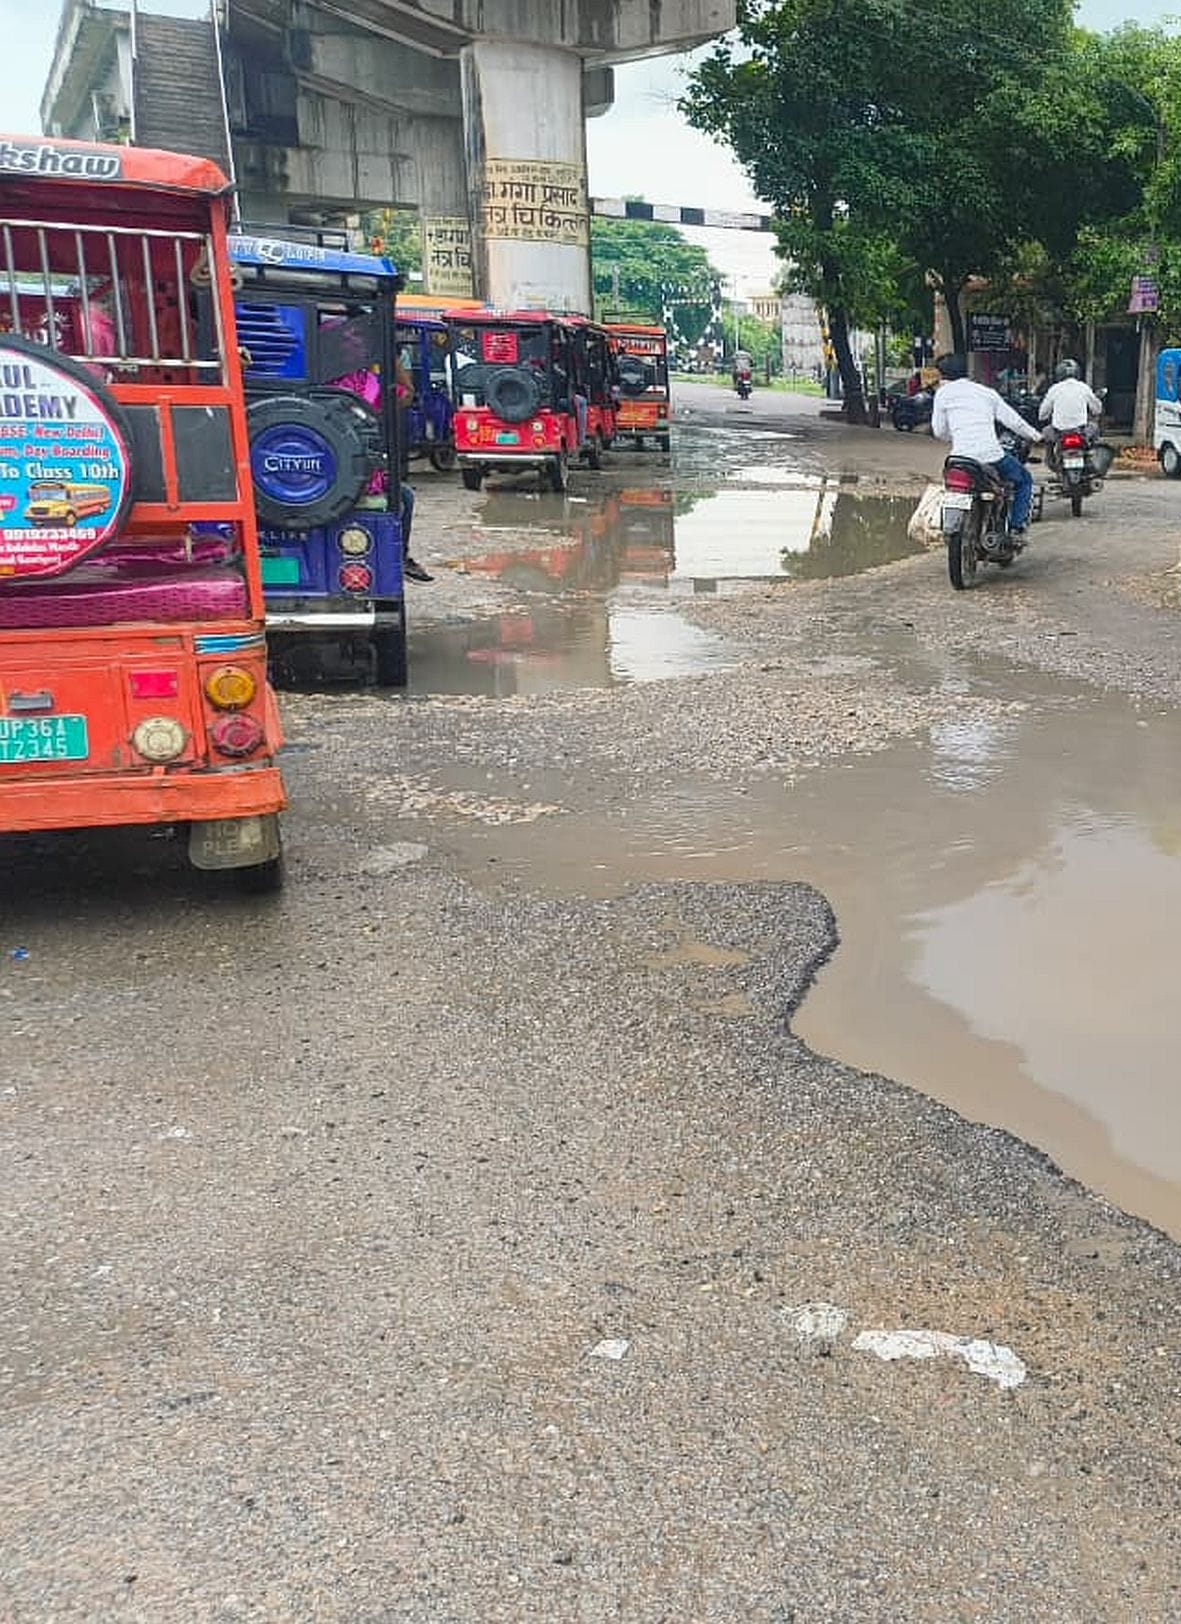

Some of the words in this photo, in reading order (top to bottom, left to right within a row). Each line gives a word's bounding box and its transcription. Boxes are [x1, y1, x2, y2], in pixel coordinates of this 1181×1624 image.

[0, 365, 36, 390] UL
[0, 394, 77, 419] DEMY
[26, 461, 72, 479] Class
[81, 461, 118, 478] 10th
